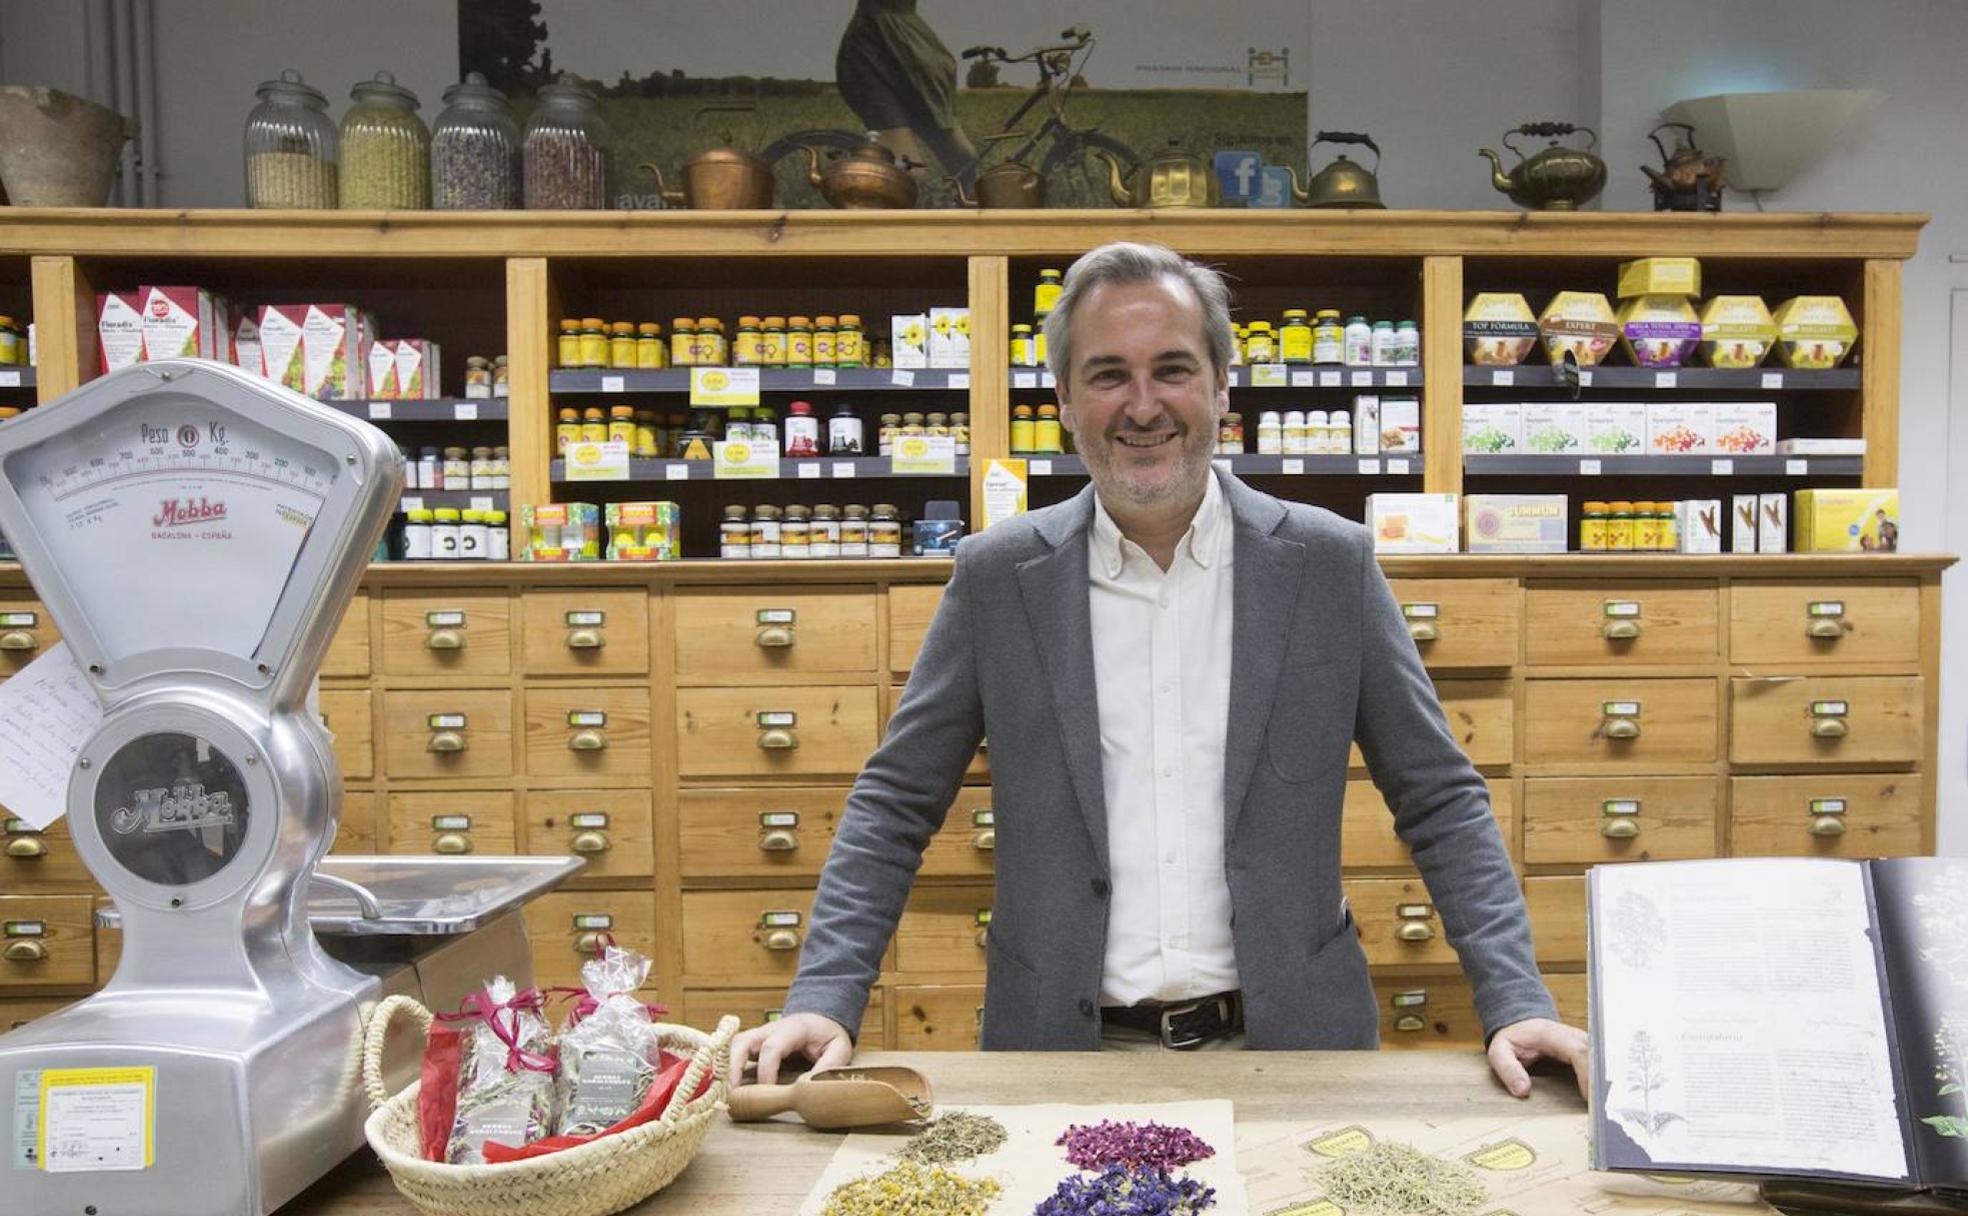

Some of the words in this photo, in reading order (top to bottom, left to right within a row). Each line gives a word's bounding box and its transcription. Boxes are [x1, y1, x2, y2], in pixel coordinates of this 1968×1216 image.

[1472, 322, 1489, 330] TOP
[141, 423, 169, 444] Peso
[182, 449, 196, 458] 500
[214, 446, 228, 456] 400
[274, 458, 289, 468] 200
